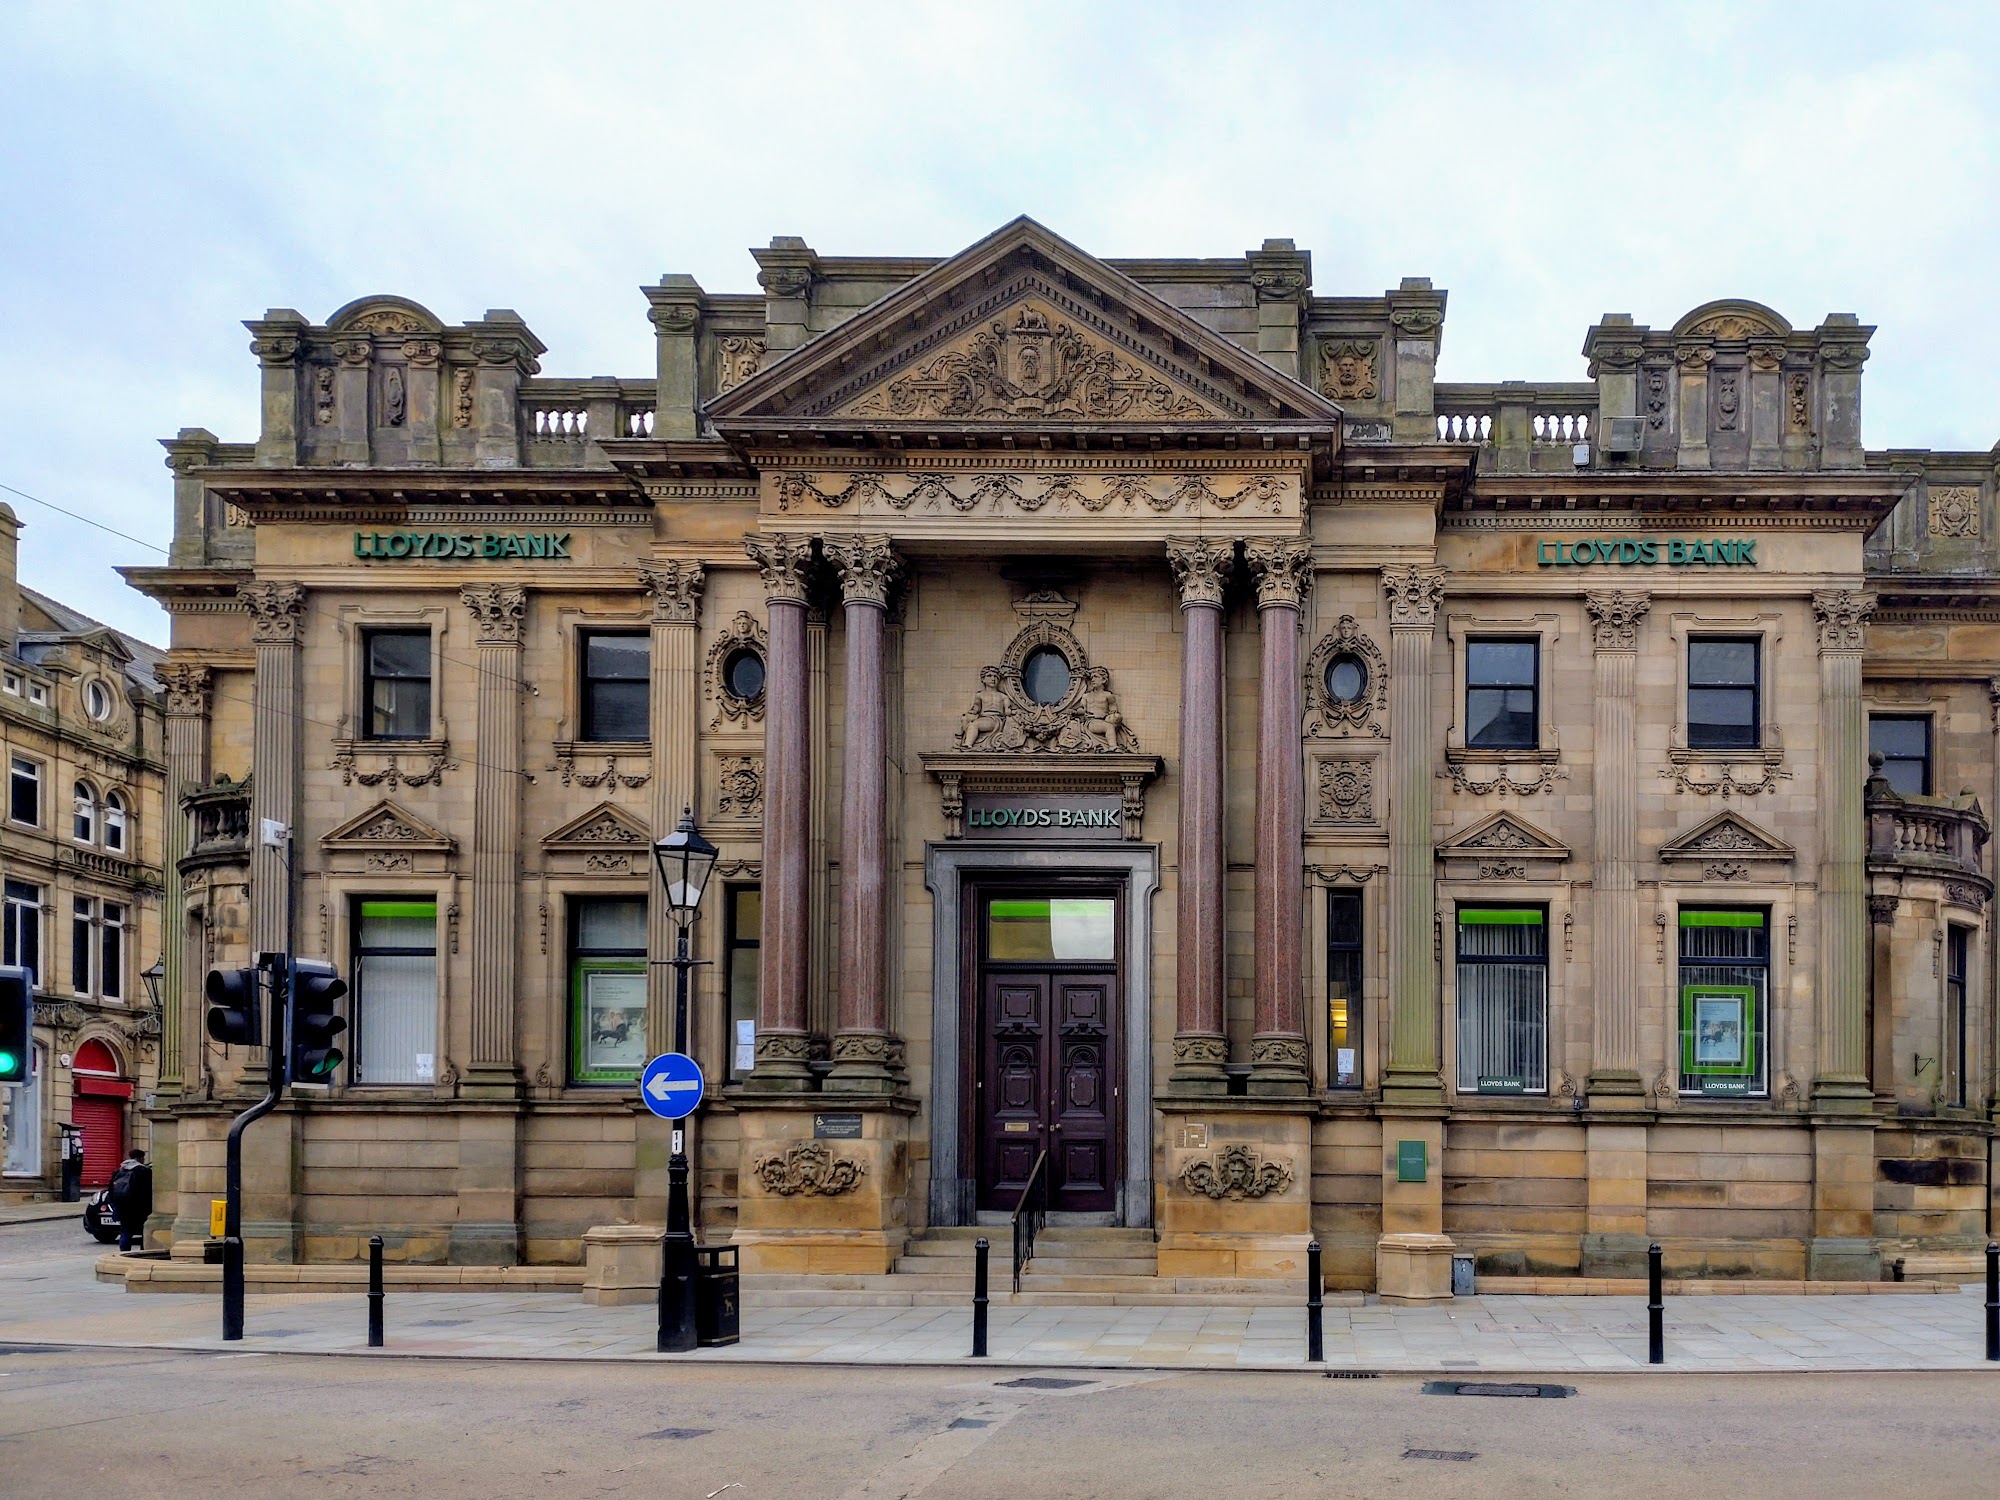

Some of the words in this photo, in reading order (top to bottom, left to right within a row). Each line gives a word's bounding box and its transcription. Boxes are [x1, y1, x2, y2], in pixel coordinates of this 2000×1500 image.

[354, 532, 474, 558] LLOYDS
[481, 532, 571, 558] BANK
[1538, 538, 1659, 565] LLOYDS
[1668, 538, 1758, 565] BANK
[968, 808, 1050, 827] LLOYDS
[1059, 808, 1120, 827] BANK
